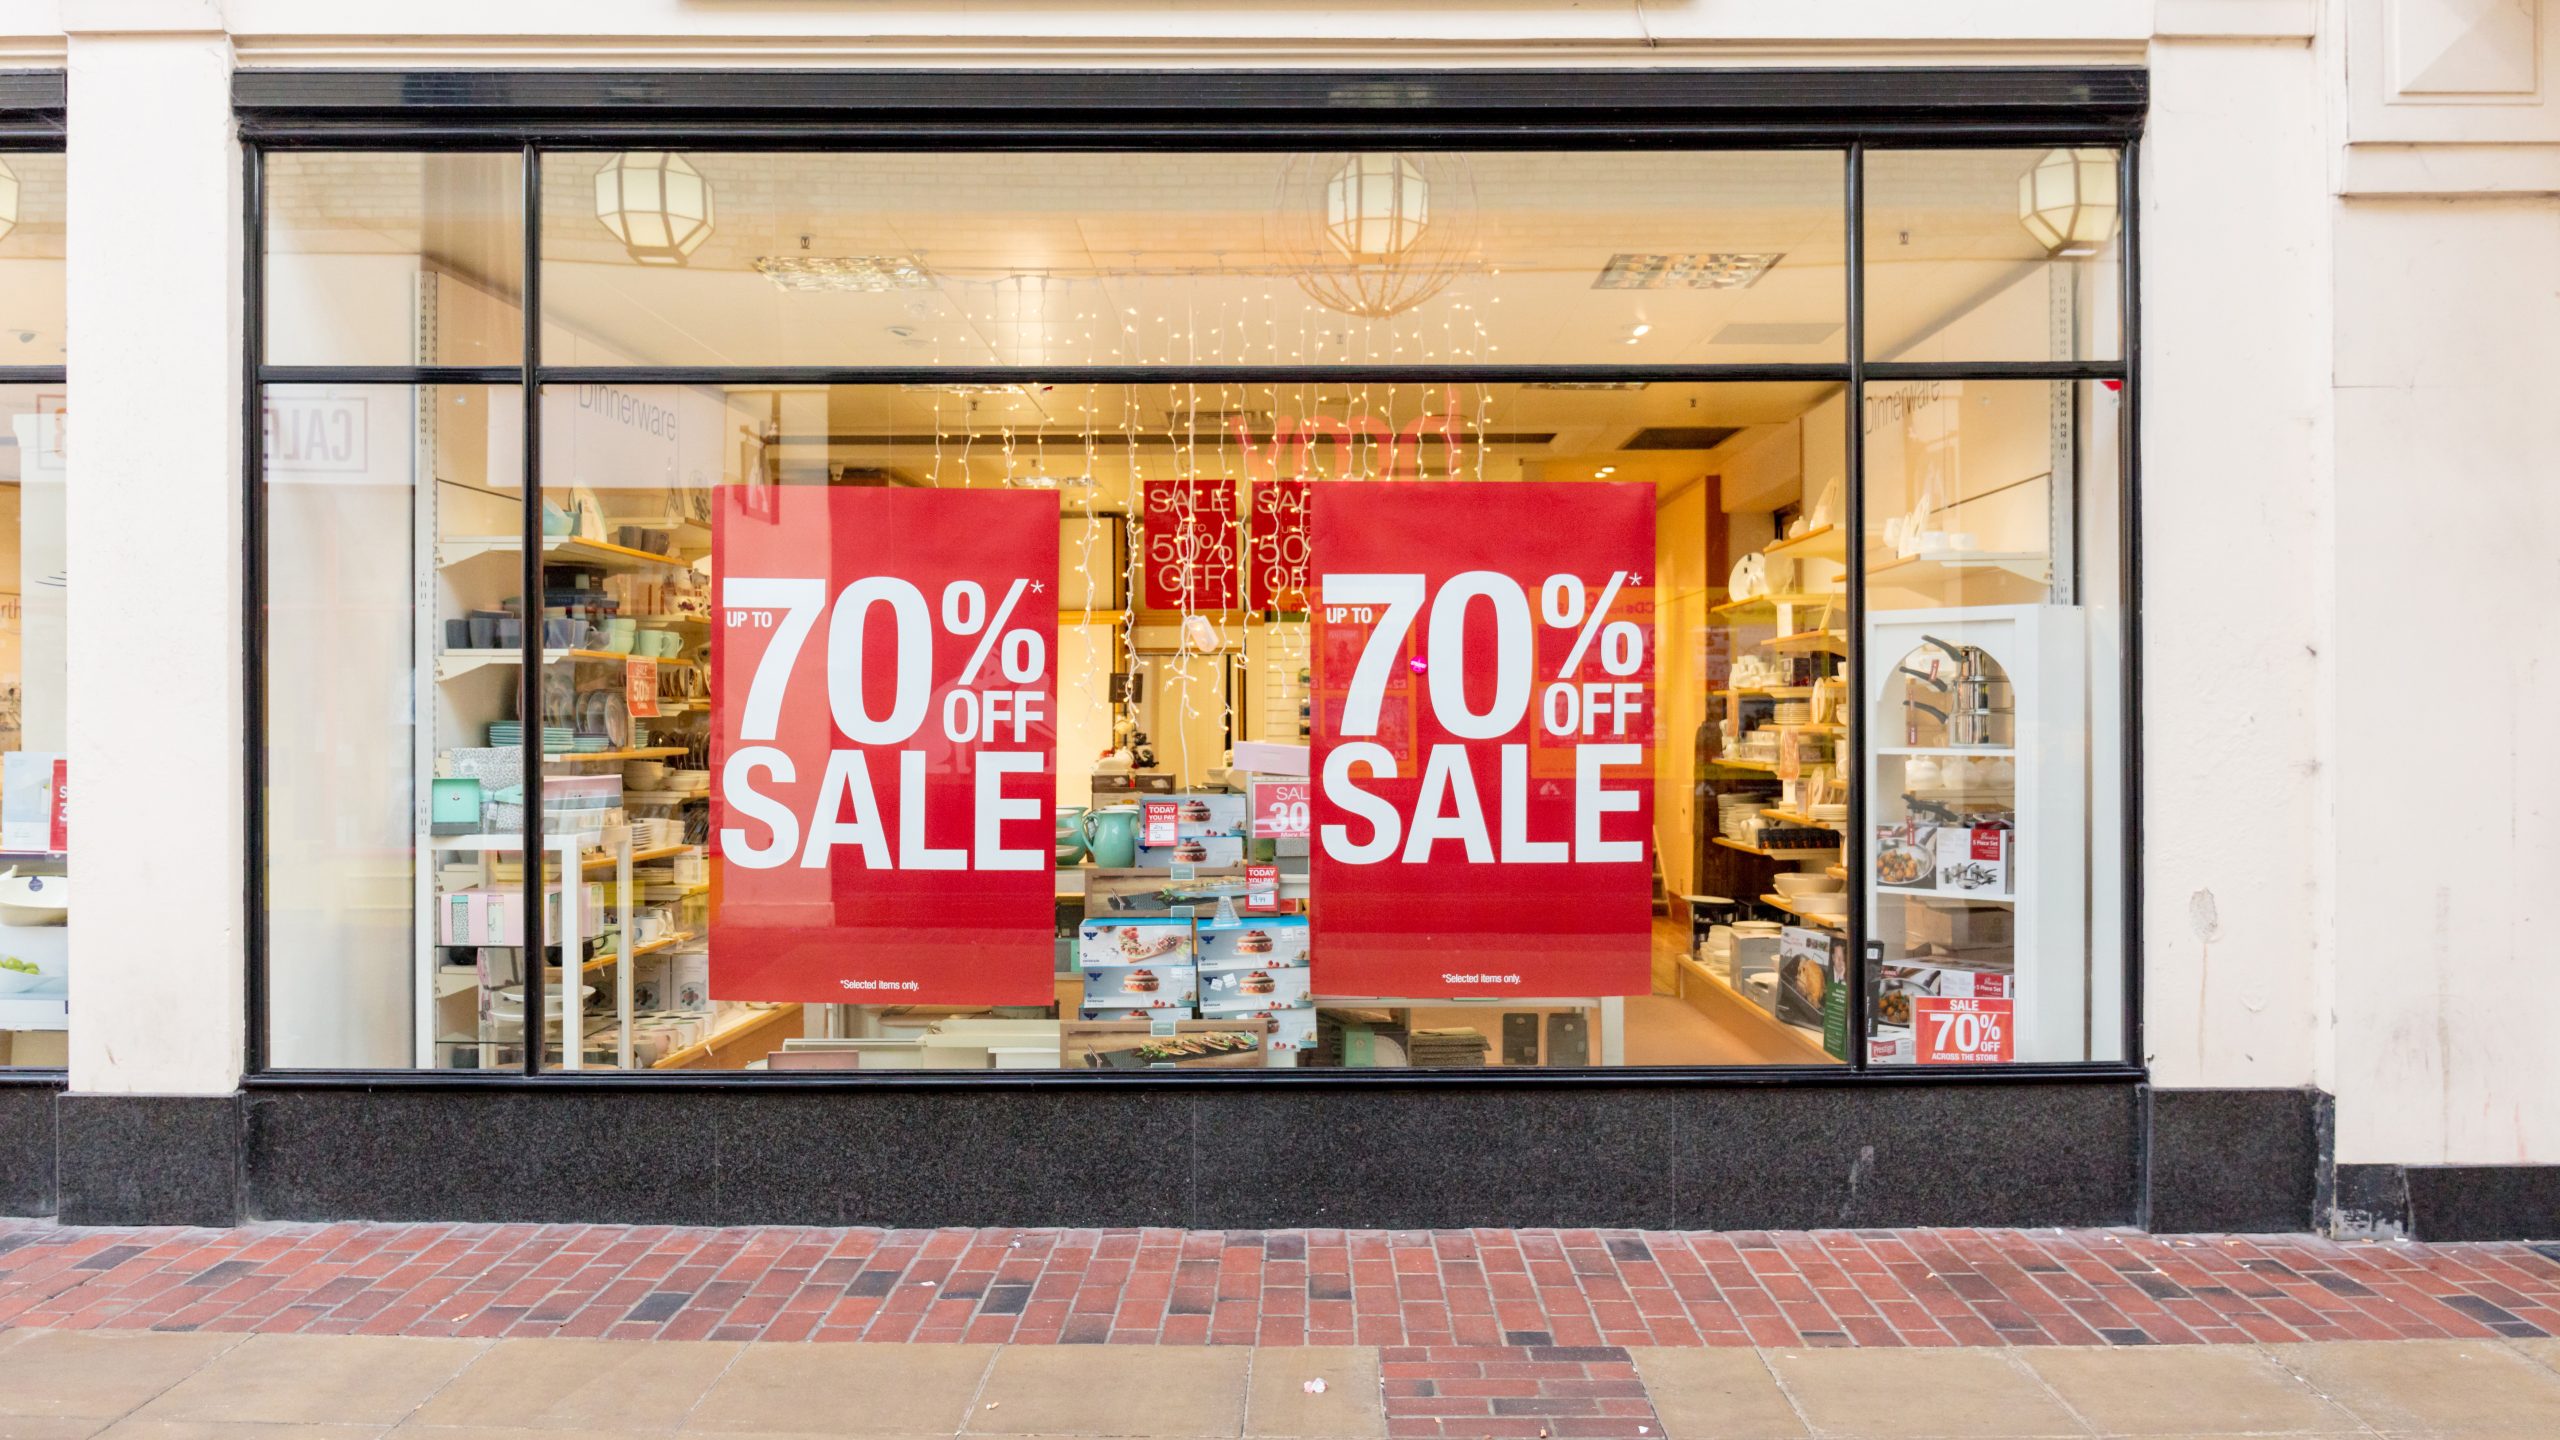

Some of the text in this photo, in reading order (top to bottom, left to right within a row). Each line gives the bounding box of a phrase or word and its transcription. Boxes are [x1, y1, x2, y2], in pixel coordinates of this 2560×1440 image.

[579, 384, 676, 441] Dinnerware
[1150, 489, 1230, 512] SALE
[1152, 533, 1233, 562] 50%
[1258, 535, 1310, 563] 50
[1159, 564, 1223, 592] OFF
[726, 611, 773, 628] UP TO
[1326, 607, 1373, 624] UP TO
[943, 688, 1045, 743] OFF
[1543, 683, 1644, 736] OFF
[720, 745, 1045, 871] SALE
[1149, 806, 1175, 814] TODAY
[1269, 802, 1310, 832] 30
[1320, 741, 1644, 865] SALE
[878, 980, 900, 990] items
[902, 980, 919, 992] only.
[1480, 973, 1502, 984] items
[1503, 974, 1521, 985] only.
[1950, 1000, 1979, 1011] SALE
[1930, 1013, 2000, 1053] 70%
[1980, 1042, 2000, 1052] OFF
[1931, 1053, 1998, 1062] ACROSS THE STORE
